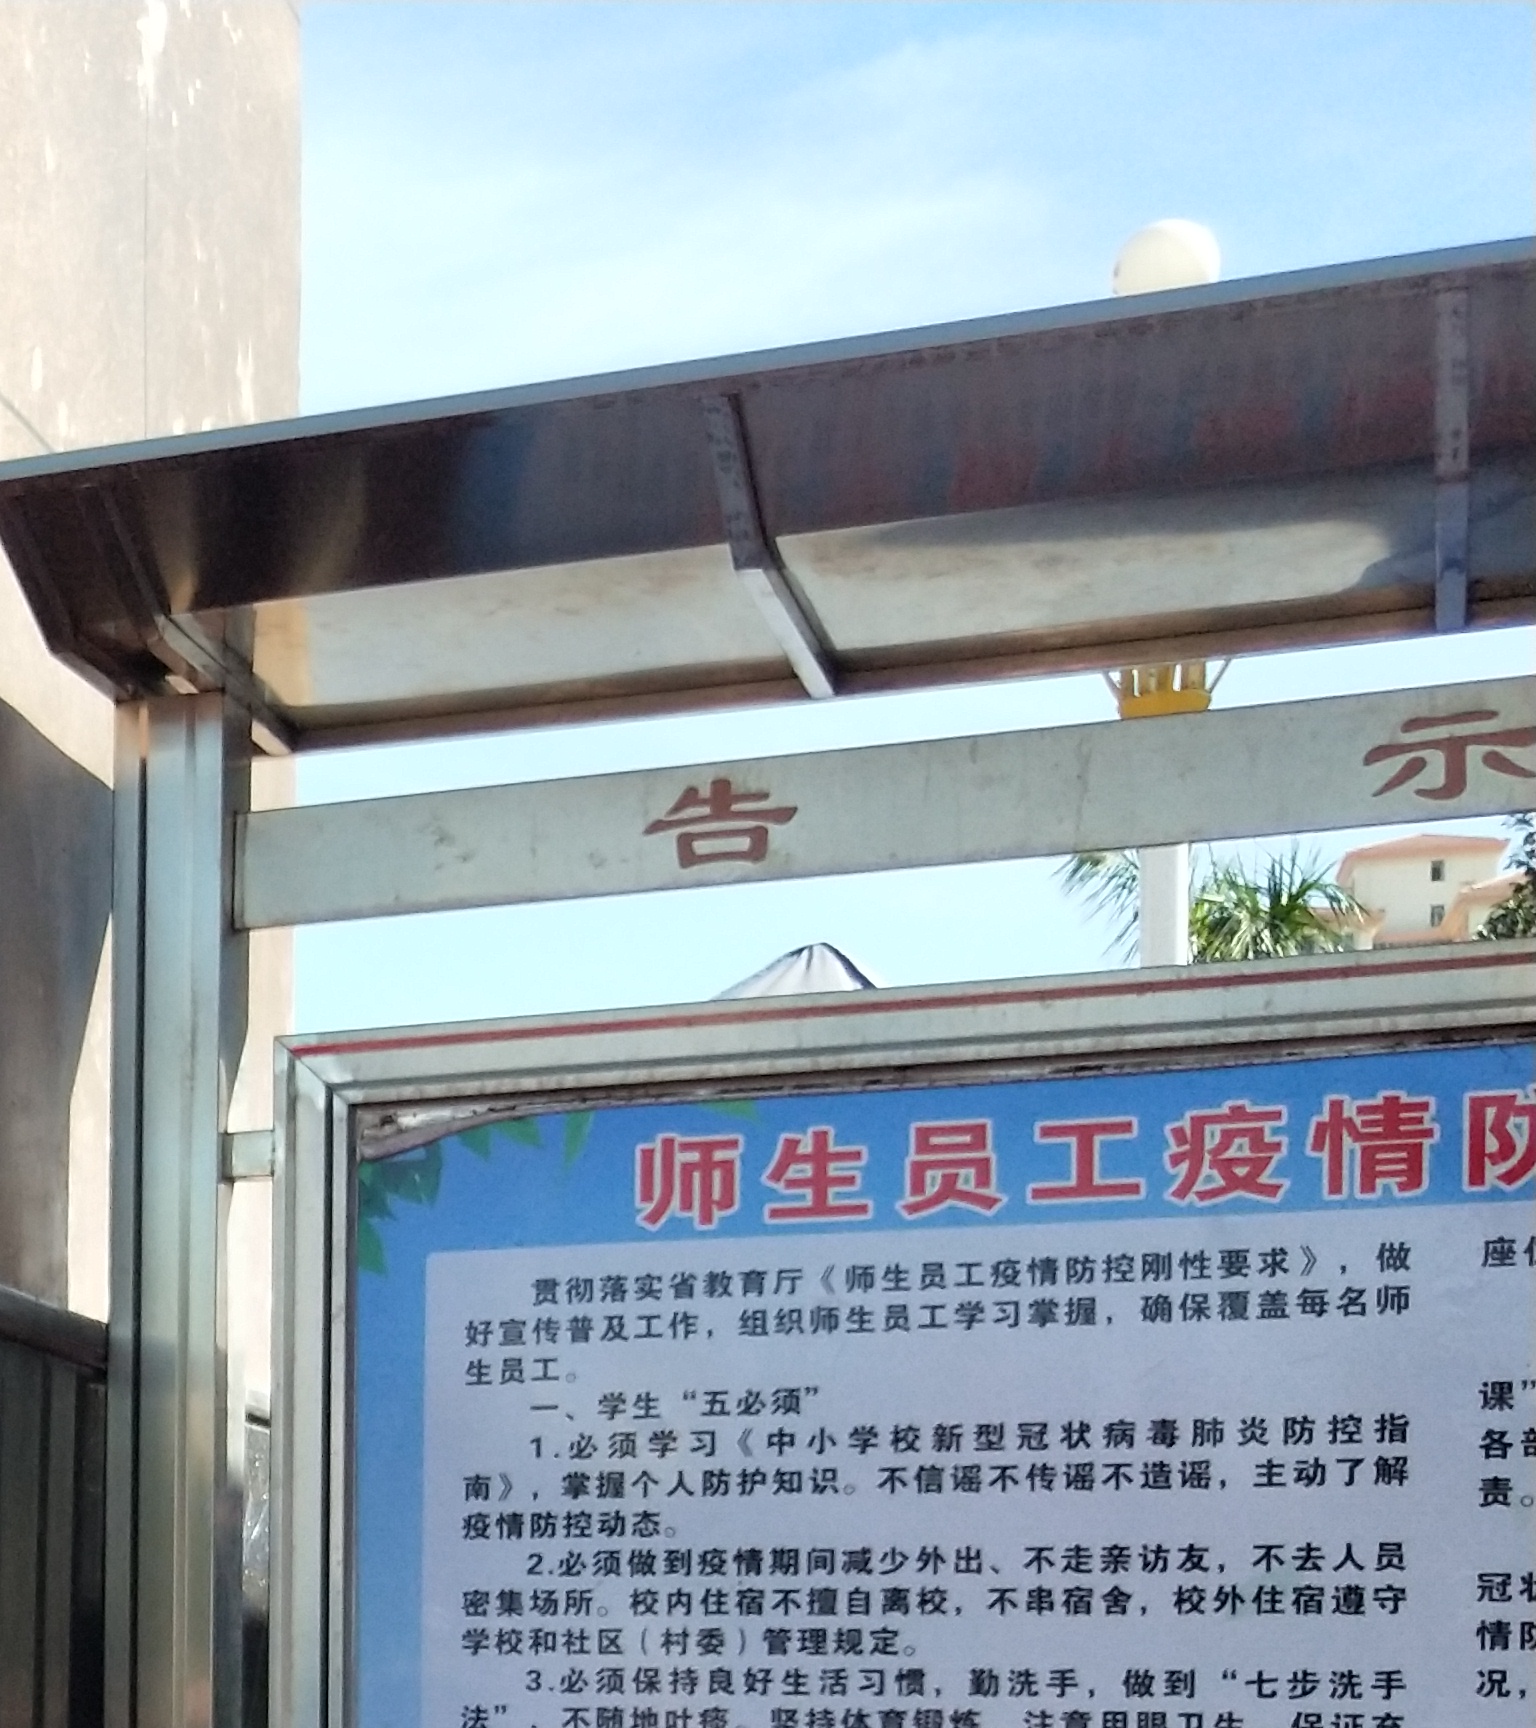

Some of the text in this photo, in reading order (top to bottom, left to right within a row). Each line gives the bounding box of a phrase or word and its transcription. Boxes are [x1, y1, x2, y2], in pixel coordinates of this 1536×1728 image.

[643, 708, 1536, 870] 告 示
[635, 1092, 1536, 1230] 师生员工疫情防
[464, 1357, 577, 1387] 生员工。
[529, 1385, 820, 1421] 一、学生“五必须”
[1478, 1475, 1534, 1508] 责。
[462, 1509, 677, 1540] 疫情防控动态。
[1476, 1669, 1526, 1698] 况，
